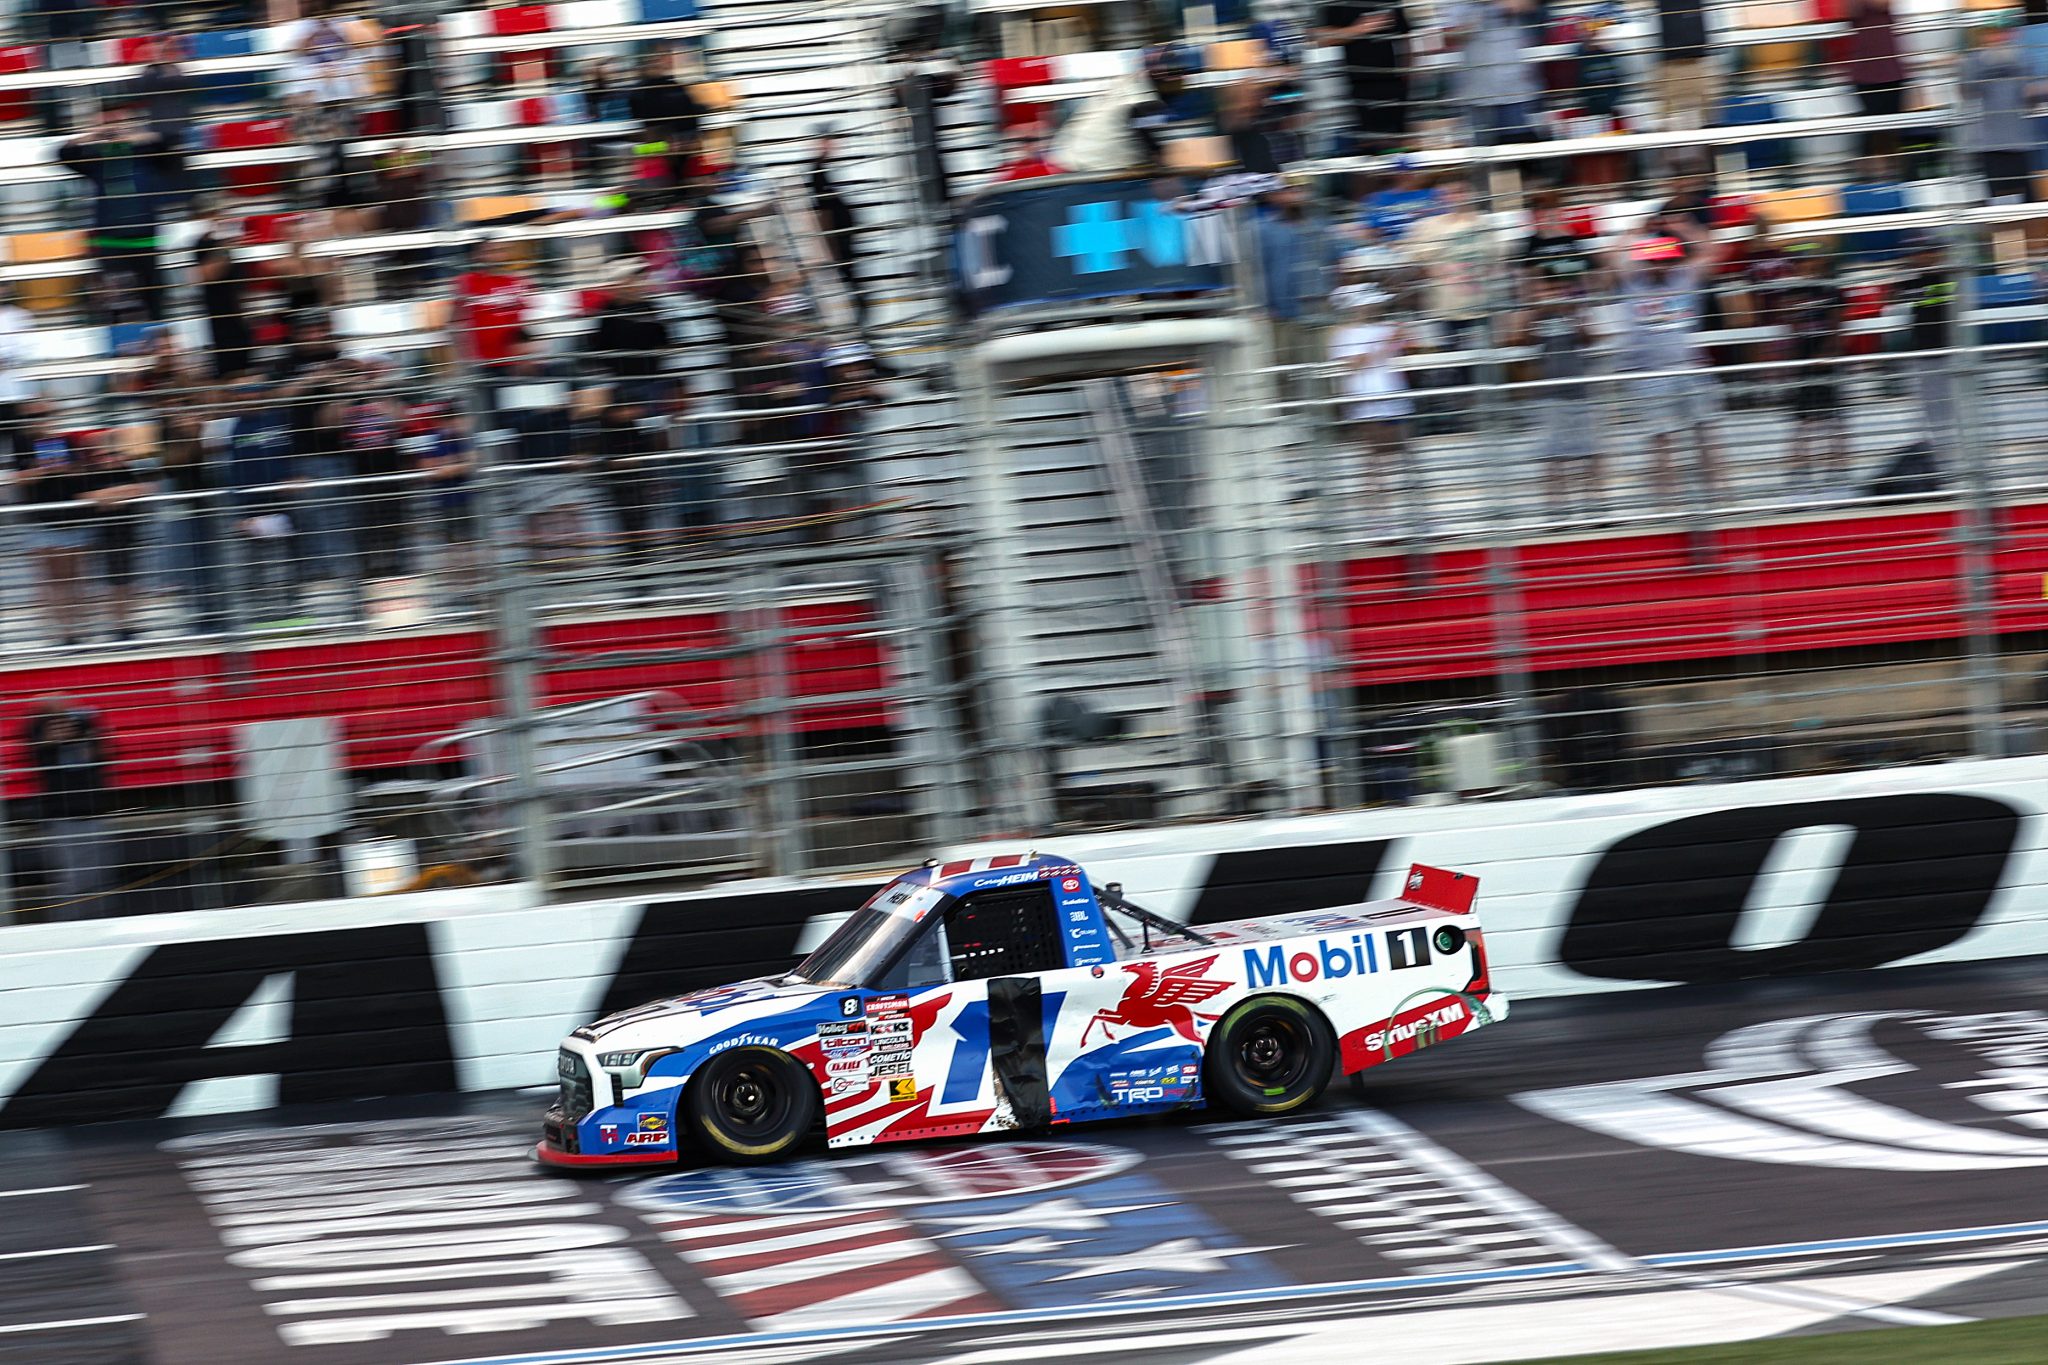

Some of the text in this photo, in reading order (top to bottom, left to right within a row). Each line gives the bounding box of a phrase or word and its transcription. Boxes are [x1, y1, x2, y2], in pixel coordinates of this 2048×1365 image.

[1001, 871, 1040, 885] HEIM
[1243, 930, 1417, 989] Mobil 1
[1364, 1002, 1466, 1052] SiriusXM
[709, 1032, 779, 1055] GOODYEAR
[824, 1037, 867, 1048] tilton
[870, 1050, 911, 1064] COMETIC
[870, 1062, 914, 1077] JESEL
[1111, 1086, 1163, 1104] TRD
[626, 1132, 669, 1143] ARP
